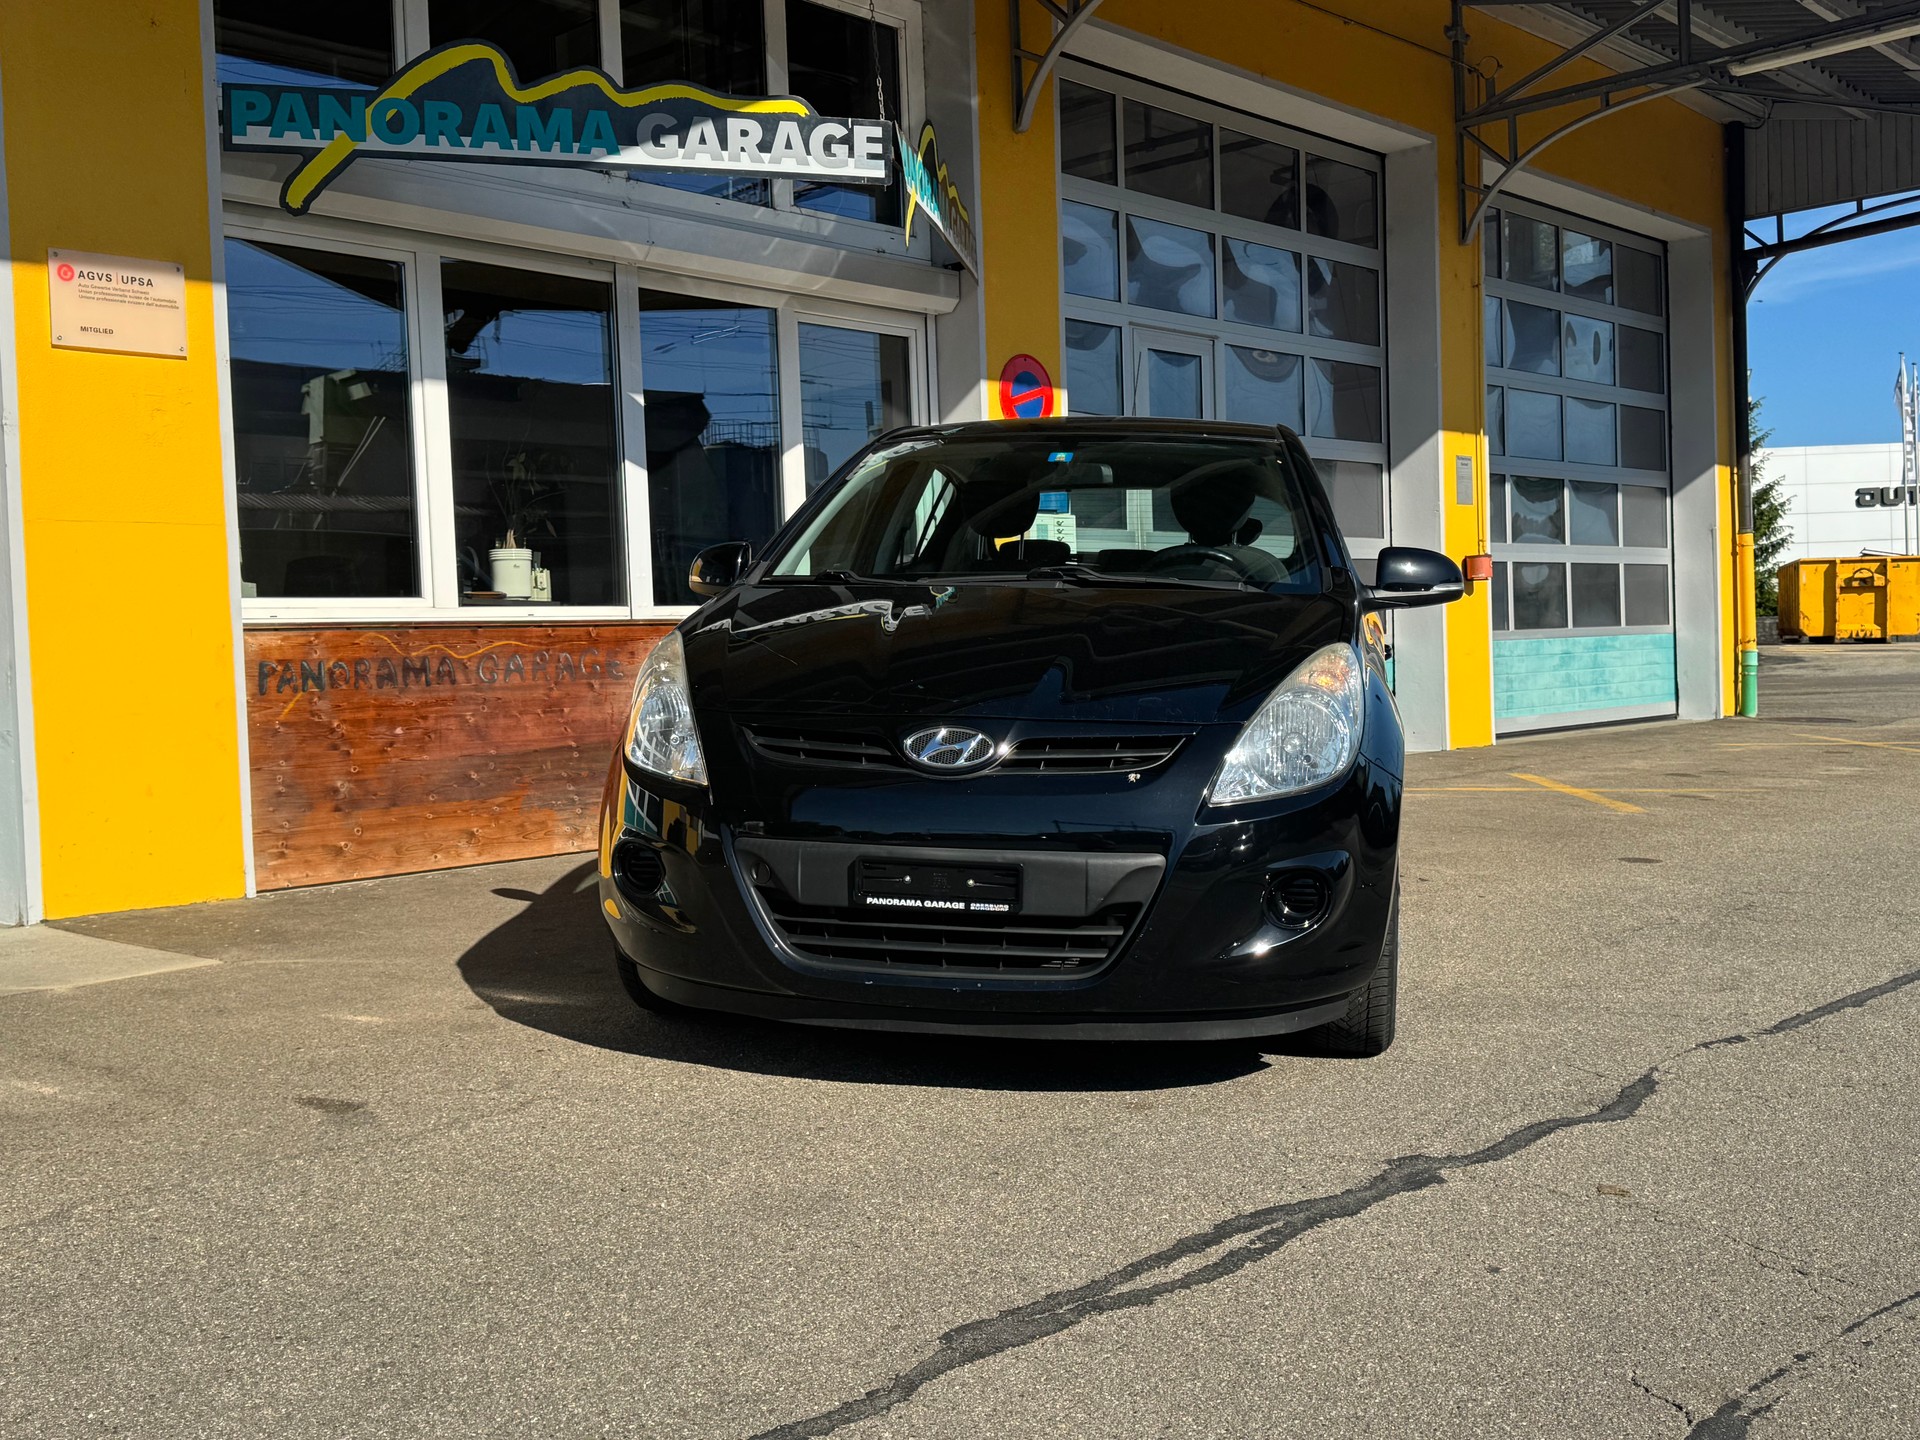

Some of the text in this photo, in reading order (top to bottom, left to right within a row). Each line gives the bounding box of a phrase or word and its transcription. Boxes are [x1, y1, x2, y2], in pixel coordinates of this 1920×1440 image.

[231, 89, 885, 169] PANORAMA GARAGE
[78, 270, 154, 287] AGVS UPSA
[80, 325, 114, 335] MITGLIED
[258, 656, 458, 697] PANORAMA
[866, 897, 966, 910] PANORAMA GARAGE
